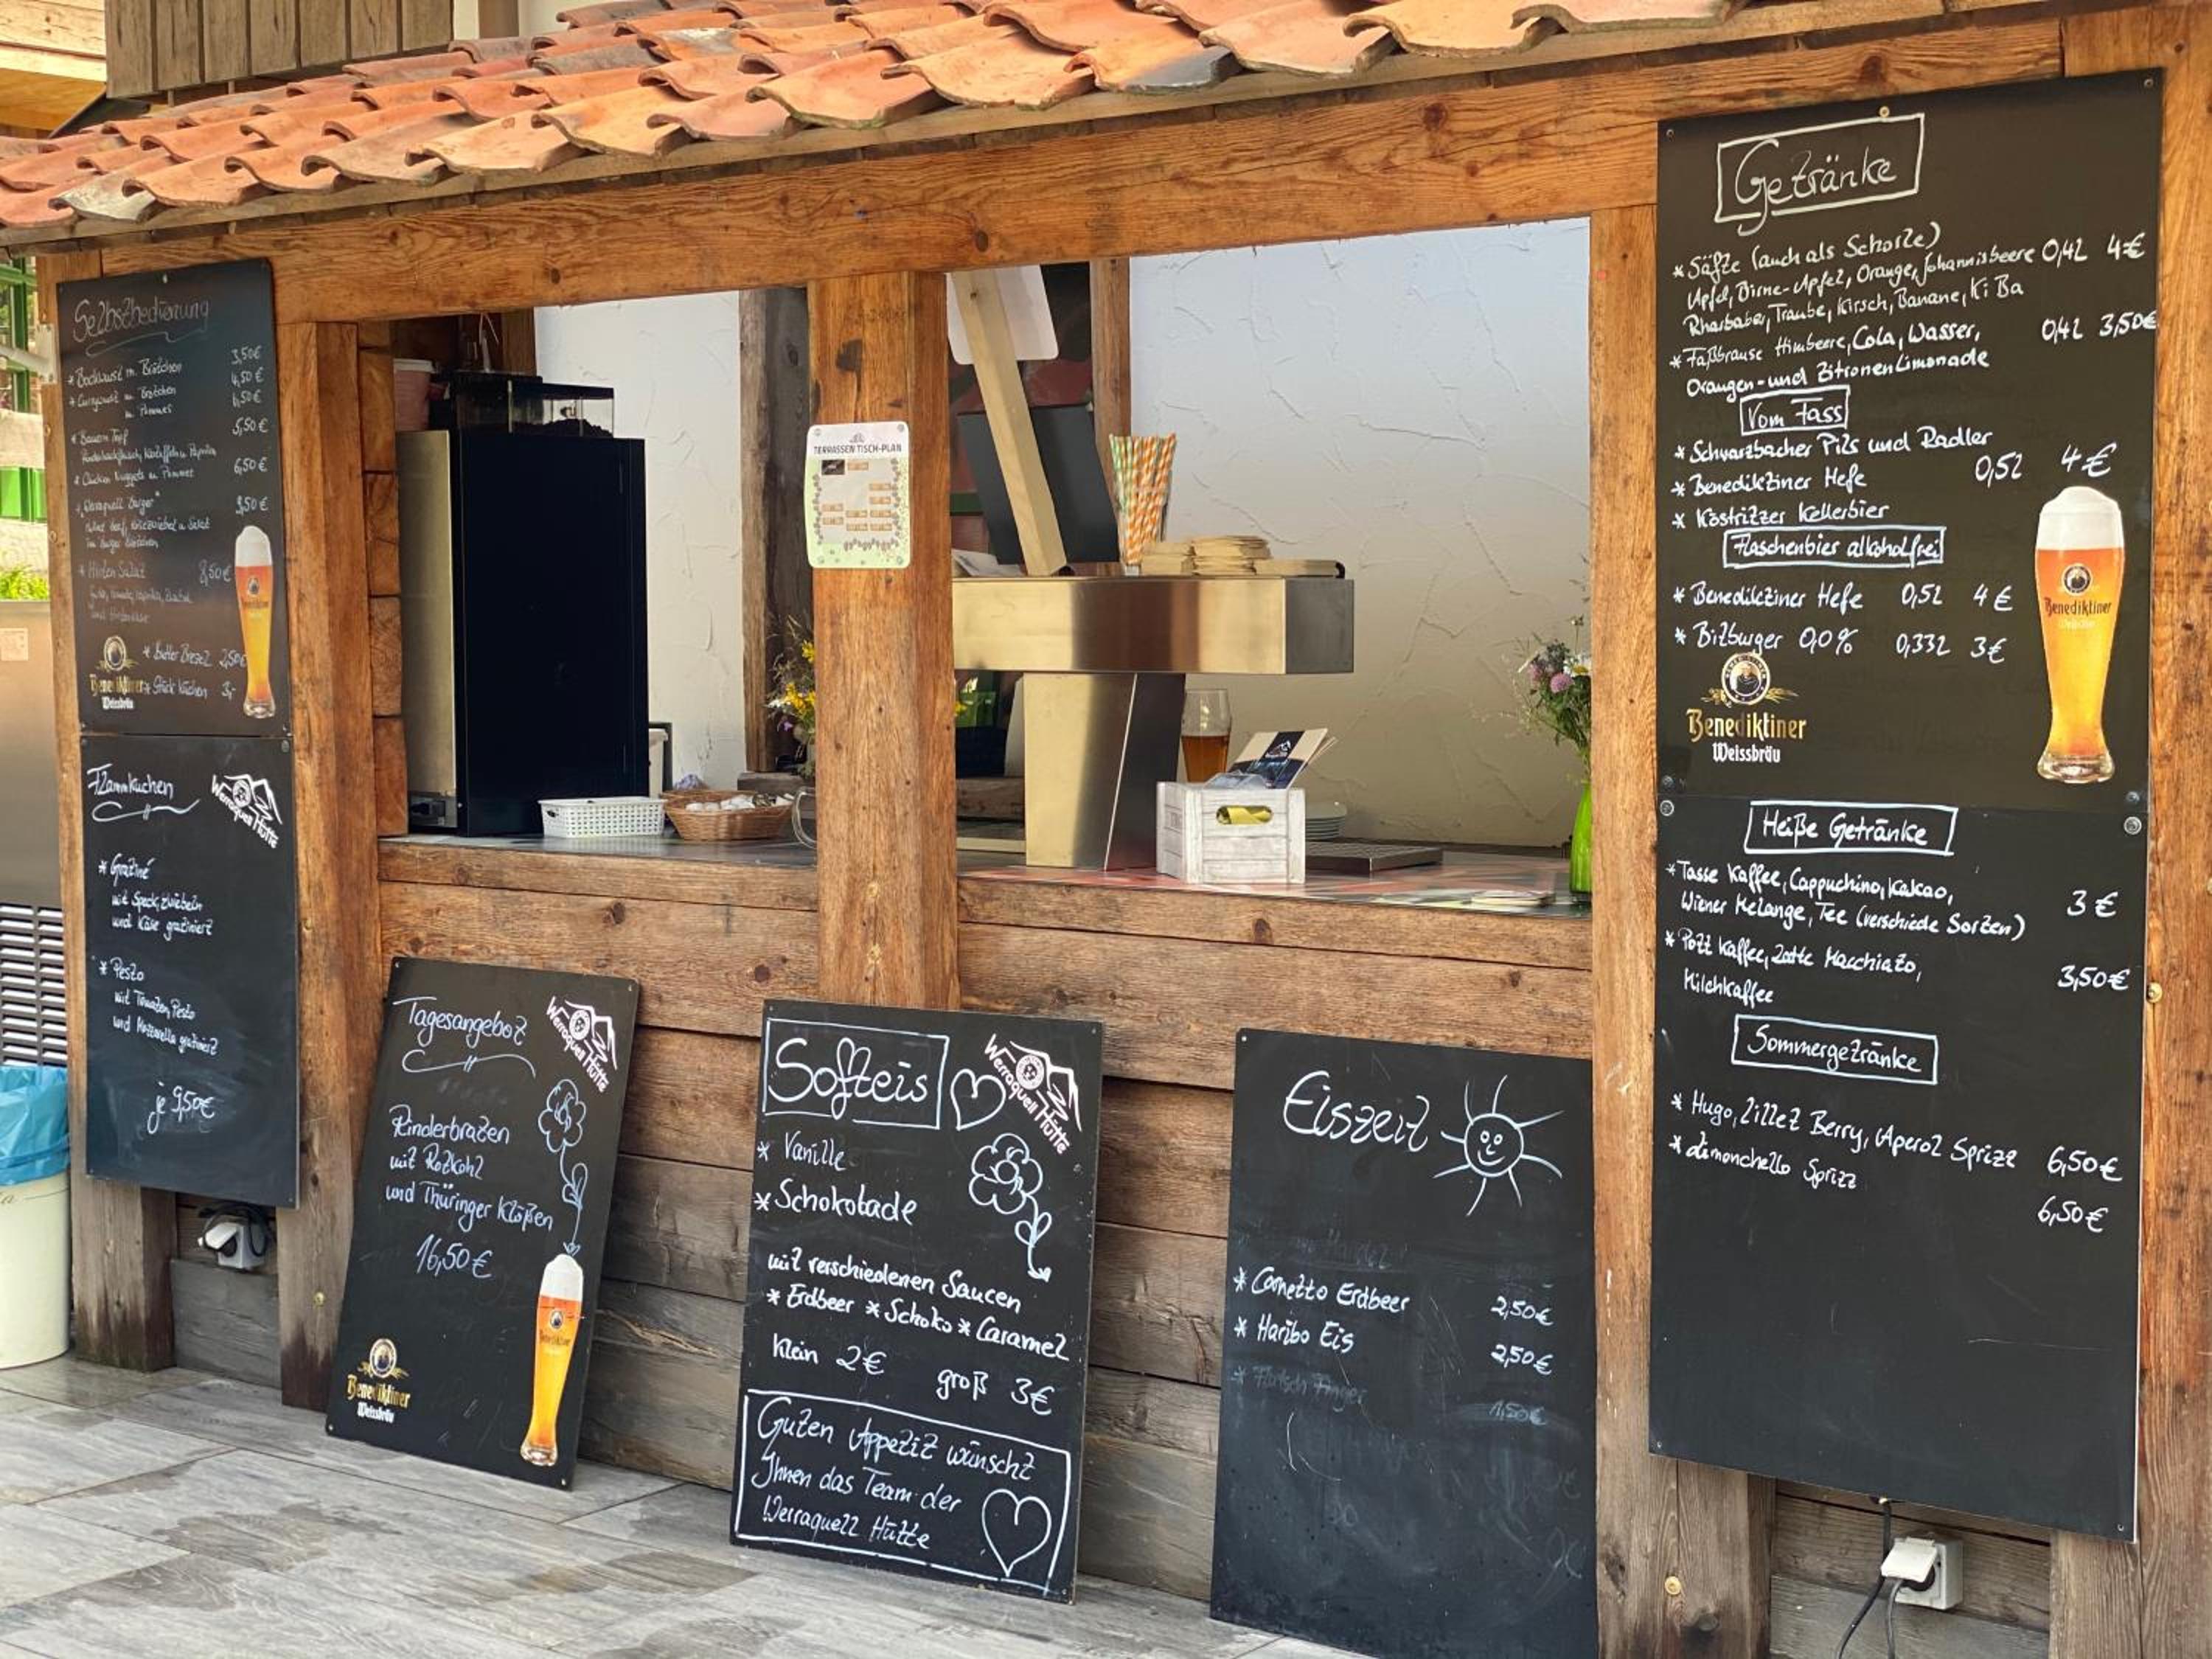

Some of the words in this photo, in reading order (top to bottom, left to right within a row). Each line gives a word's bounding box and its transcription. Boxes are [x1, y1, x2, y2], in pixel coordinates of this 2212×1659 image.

[1736, 138, 1896, 236] Getränke
[1688, 251, 1741, 283] Säfte
[1806, 242, 1834, 262] als
[1843, 222, 1941, 258] Schorle)
[1747, 403, 1784, 428] Vom
[1791, 398, 1843, 424] Fass
[1817, 434, 1859, 455] Pils
[1868, 431, 1910, 452] und
[1917, 426, 1993, 449] Radler
[1689, 470, 1811, 496] Benediktiner
[1824, 464, 1868, 493] Hefe
[1798, 500, 1889, 524] Kellerbier
[1731, 533, 1840, 558] Flaschenbier
[1847, 538, 1940, 568] alkoholfrei
[1691, 582, 1805, 608] Benediktiner
[1818, 580, 1863, 610] Hefe
[2044, 597, 2112, 617] Benediktiner
[1694, 620, 1782, 655] Bitburger
[1687, 708, 1806, 742] Benediktiner
[1712, 742, 1780, 763] Weissbräu
[86, 763, 173, 800] Flammkuchen
[1764, 813, 1818, 840] Heiße
[1829, 815, 1927, 848] Getränke
[1677, 860, 1718, 883] Tasse
[112, 913, 132, 928] und
[1680, 891, 1727, 914] Wiener
[1815, 901, 1848, 925] Tee
[1947, 913, 2025, 942] Sorten)
[111, 956, 145, 981] Pesto
[1677, 927, 1713, 956] Pott
[2057, 964, 2129, 991] 3,50€
[1683, 967, 1773, 1009] Milchkaffee
[392, 995, 528, 1048] Tagesangebot
[1747, 1024, 1921, 1073] Sommergetränke
[768, 1037, 928, 1120] Softeis
[984, 1033, 1039, 1114] Werraquell
[389, 1104, 509, 1144] Rinderbraten
[1283, 1069, 1430, 1152] Eiszeit
[785, 1130, 846, 1172] Vanille
[1739, 1096, 1801, 1130] Lillet
[1876, 1124, 1942, 1157] Aperol
[2047, 1146, 2123, 1181] 6,50€
[389, 1146, 417, 1169] mit
[423, 1143, 484, 1180] Rotkohl
[386, 1181, 415, 1203] und
[419, 1180, 493, 1232] Thüringer
[497, 1195, 553, 1232] Klößen
[775, 1178, 918, 1225] Schokolade
[2037, 1195, 2108, 1233] 6,50€
[768, 1247, 802, 1272] mit
[808, 1254, 935, 1294] verschiedenen
[942, 1268, 1022, 1314] Saucen
[1336, 1282, 1410, 1314] Erdbeer
[1489, 1295, 1554, 1326] 2,50€
[1256, 1312, 1310, 1347] Haribo
[1319, 1321, 1354, 1354] Eis
[1491, 1343, 1554, 1376] 2,50€
[937, 1369, 988, 1401] groß
[758, 1397, 835, 1451] Guten
[848, 1417, 939, 1463] Appetit
[947, 1441, 1036, 1481] wünscht
[820, 1467, 854, 1494] das
[863, 1466, 912, 1502] Team
[921, 1484, 962, 1512] der
[762, 1495, 859, 1542] Werraquell
[871, 1515, 931, 1550] Hütte
